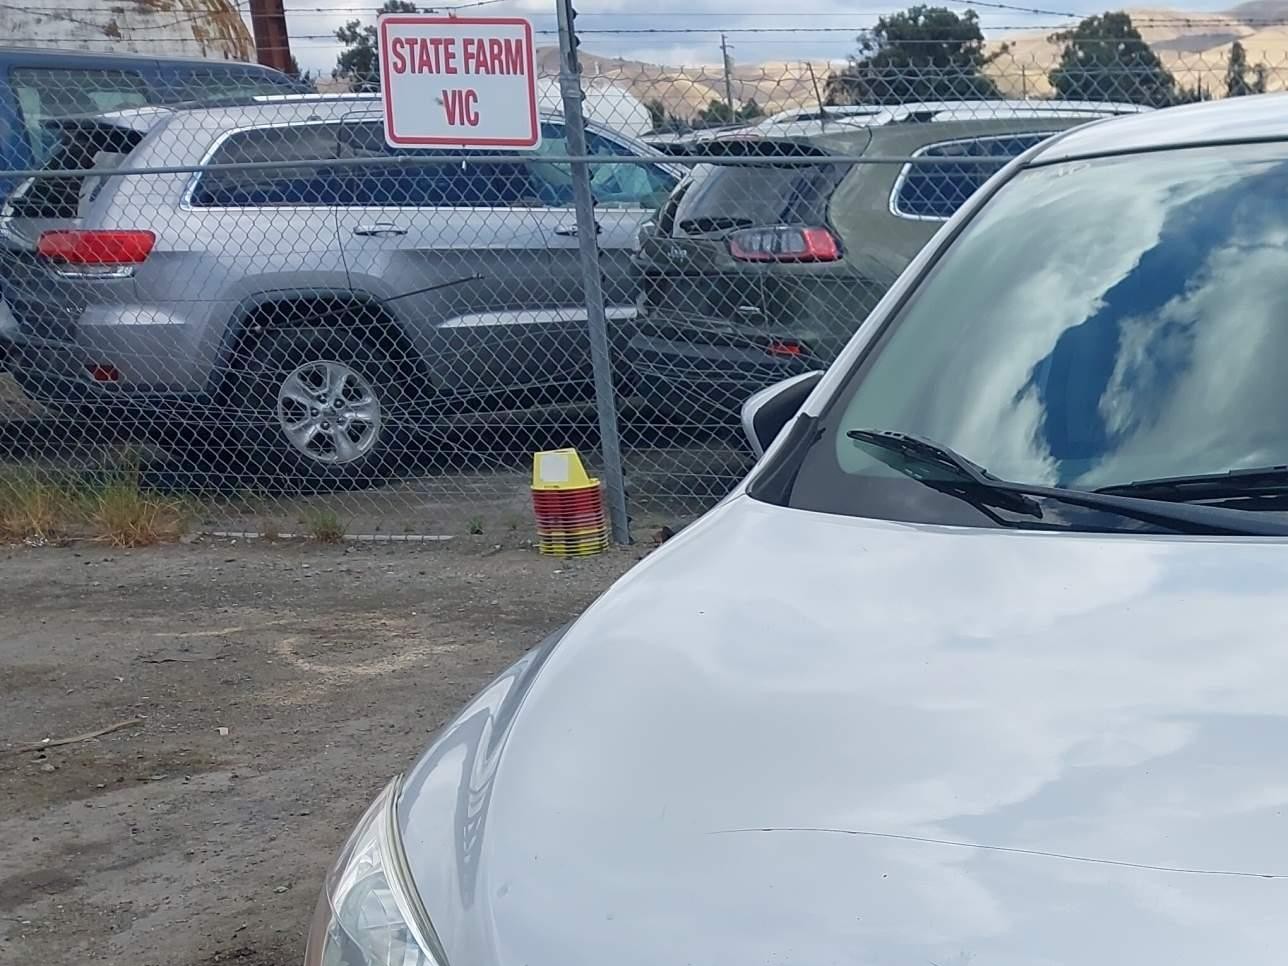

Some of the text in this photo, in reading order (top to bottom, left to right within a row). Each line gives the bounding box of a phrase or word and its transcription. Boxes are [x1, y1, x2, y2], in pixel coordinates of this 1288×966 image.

[391, 37, 525, 75] STATE FARM
[441, 89, 480, 126] VIC
